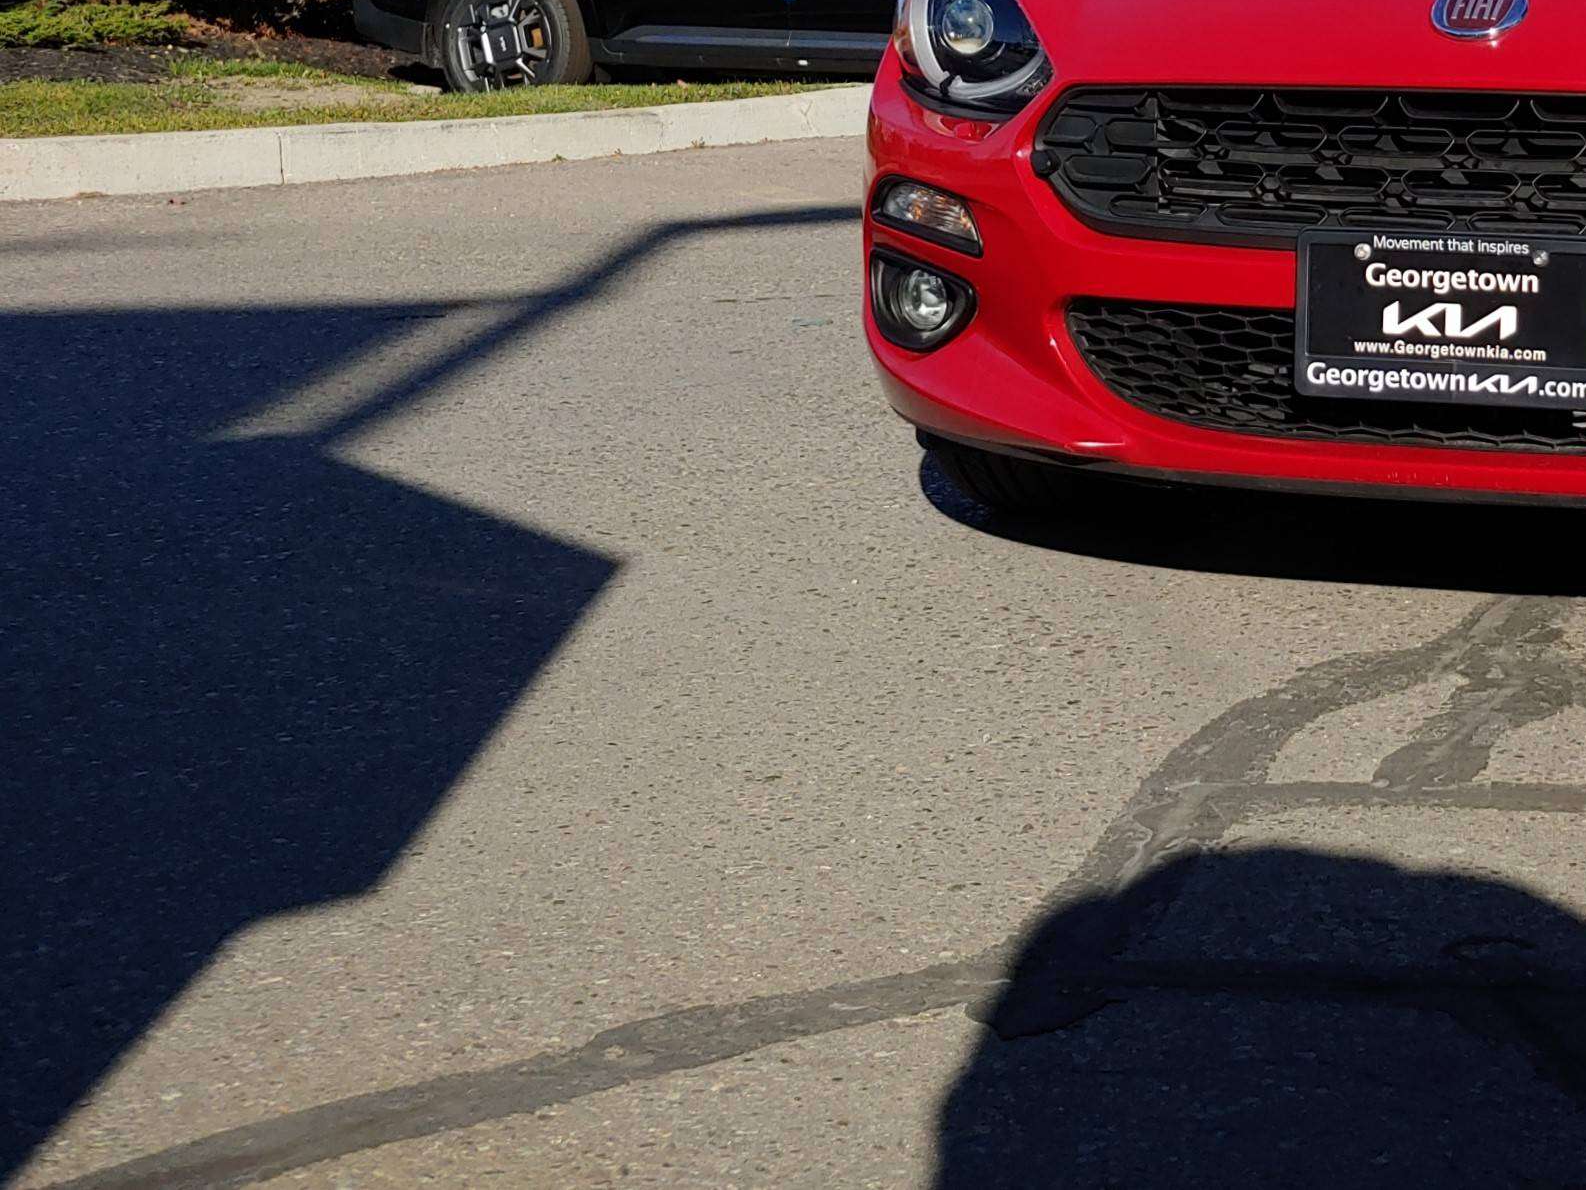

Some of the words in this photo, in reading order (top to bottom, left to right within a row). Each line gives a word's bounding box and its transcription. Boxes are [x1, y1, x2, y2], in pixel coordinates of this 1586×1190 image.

[1373, 235, 1446, 252] Movement
[1447, 238, 1474, 253] that
[1365, 262, 1540, 295] Georgetown
[1354, 339, 1547, 362] www.Georgetownkia.com
